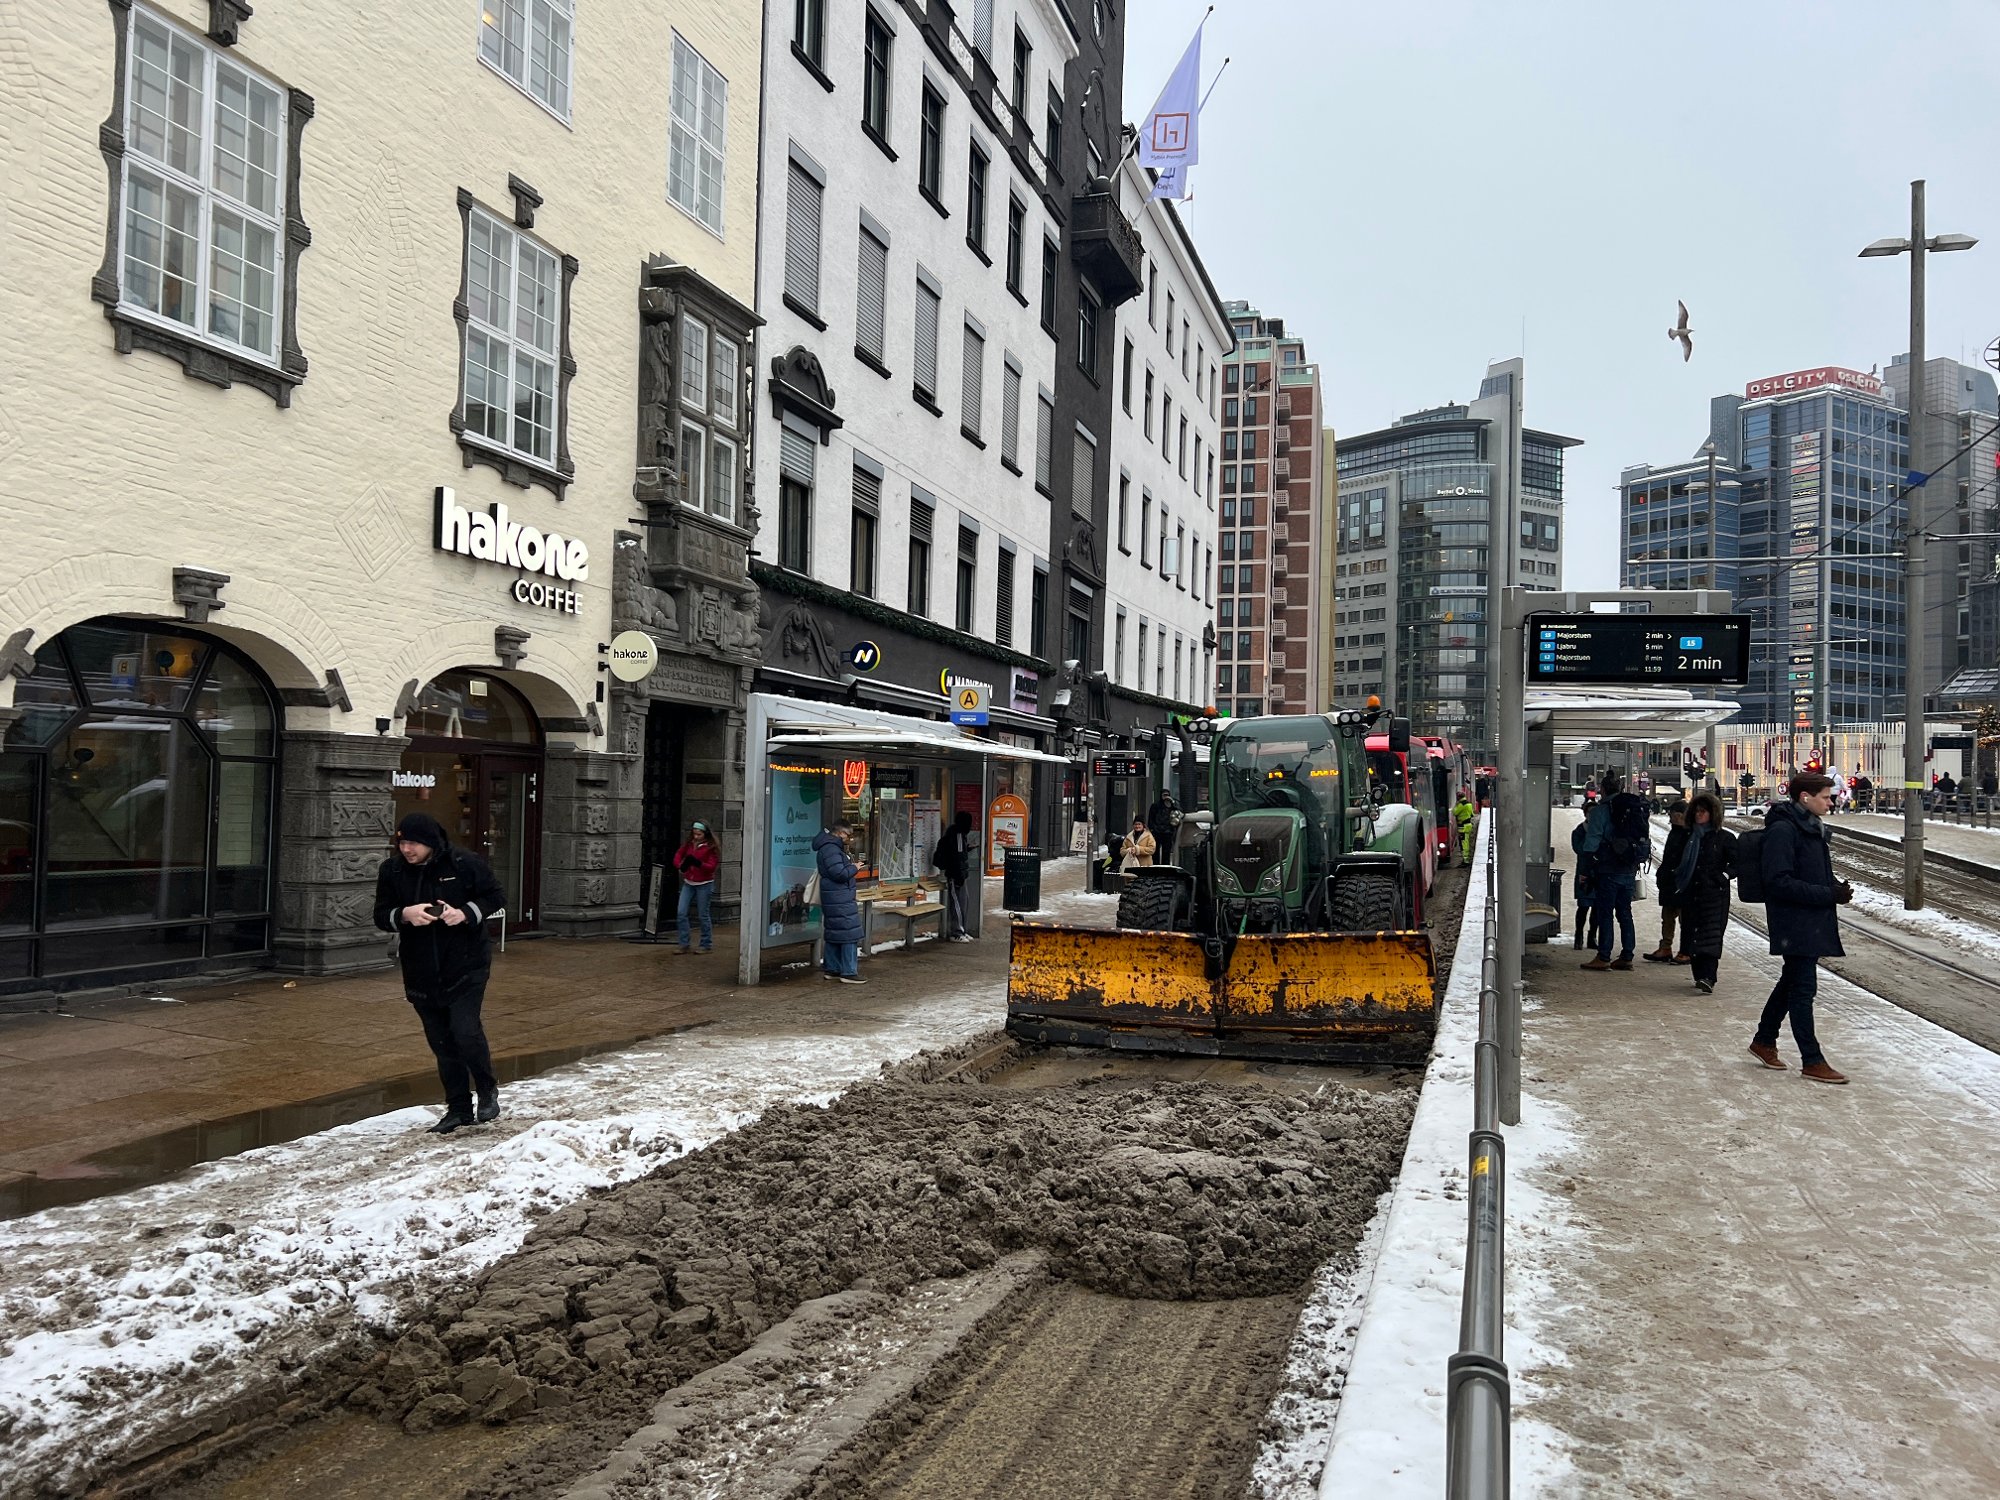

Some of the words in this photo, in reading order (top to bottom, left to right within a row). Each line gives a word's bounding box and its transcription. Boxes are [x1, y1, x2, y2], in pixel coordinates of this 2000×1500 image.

[436, 485, 589, 582] hakone
[510, 578, 584, 615] COFFEE
[1556, 643, 1577, 651] Ljabru
[1686, 639, 1696, 647] 15
[613, 648, 648, 659] hakone
[1556, 654, 1591, 662] Majorstuen
[1677, 656, 1688, 669] 2
[1692, 656, 1722, 670] min
[963, 692, 975, 706] A
[392, 770, 436, 788] hakone
